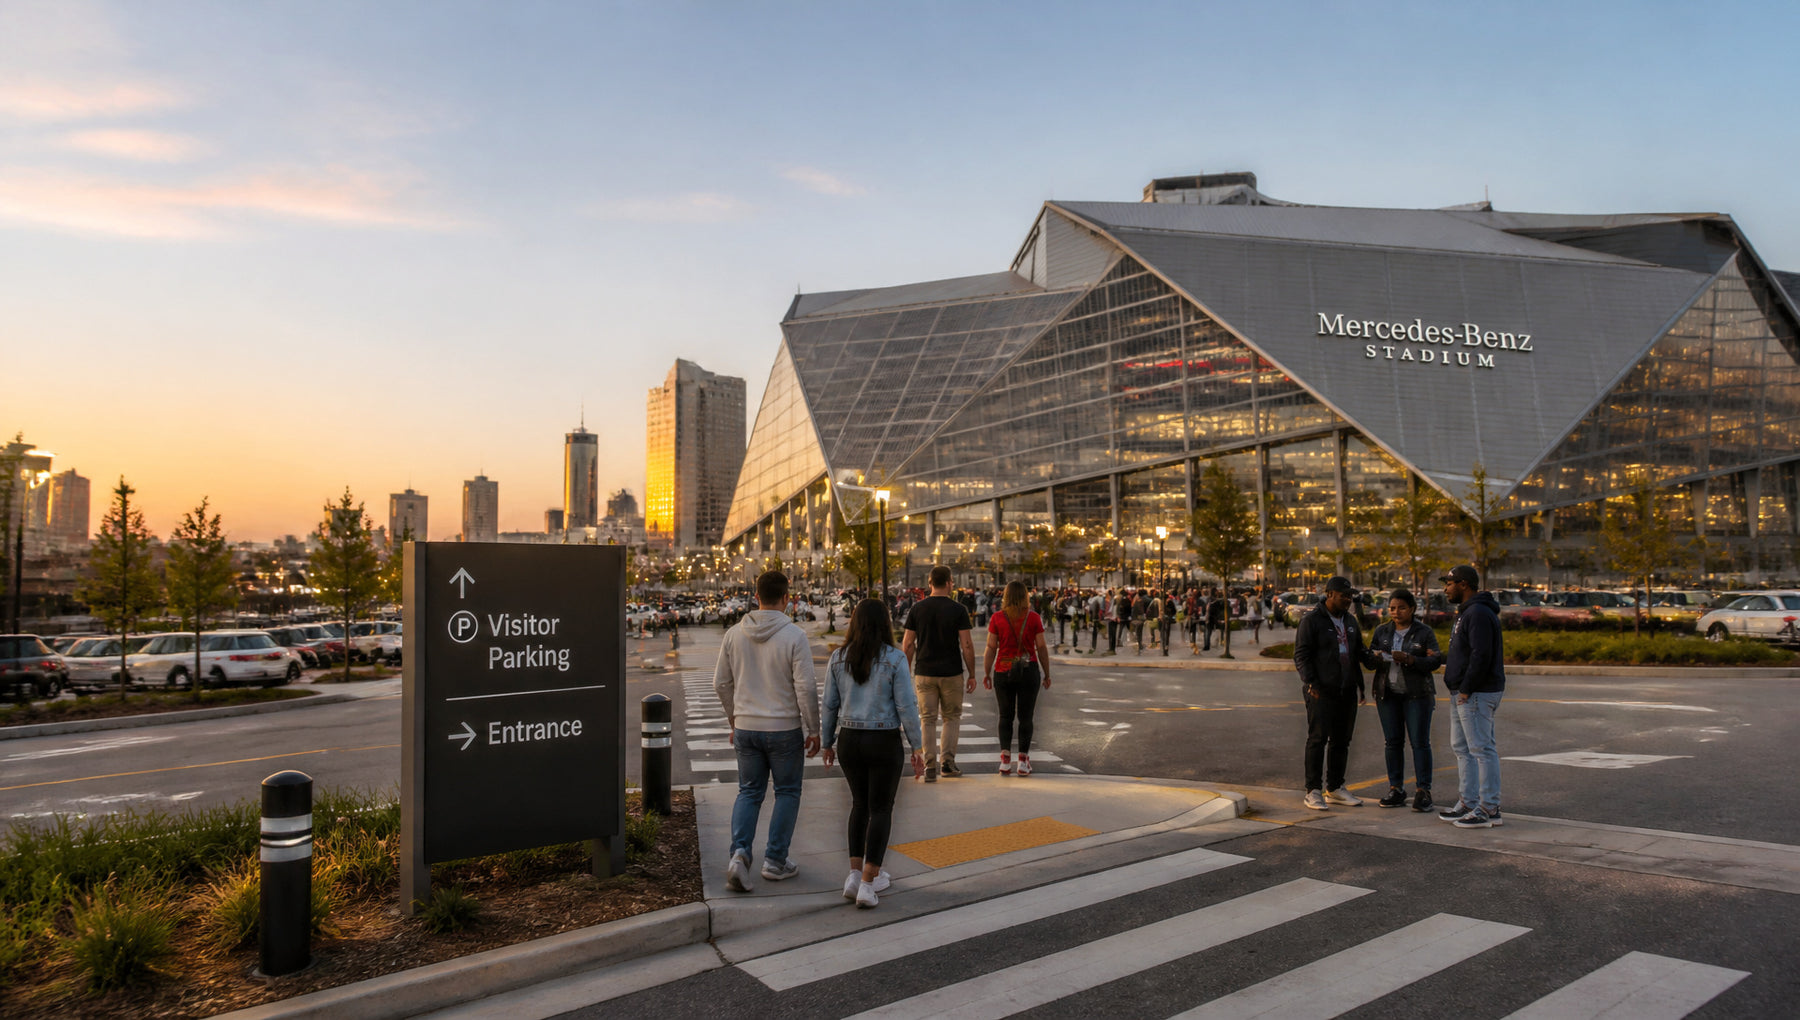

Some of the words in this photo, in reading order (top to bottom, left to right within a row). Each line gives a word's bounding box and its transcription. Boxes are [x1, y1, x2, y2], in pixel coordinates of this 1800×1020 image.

[1317, 312, 1534, 352] Mercedes-Benz
[1366, 344, 1495, 368] STADIUM
[457, 617, 471, 636] P
[487, 613, 560, 636] Visitor
[488, 644, 570, 671] Parking
[488, 719, 583, 744] Entrance
